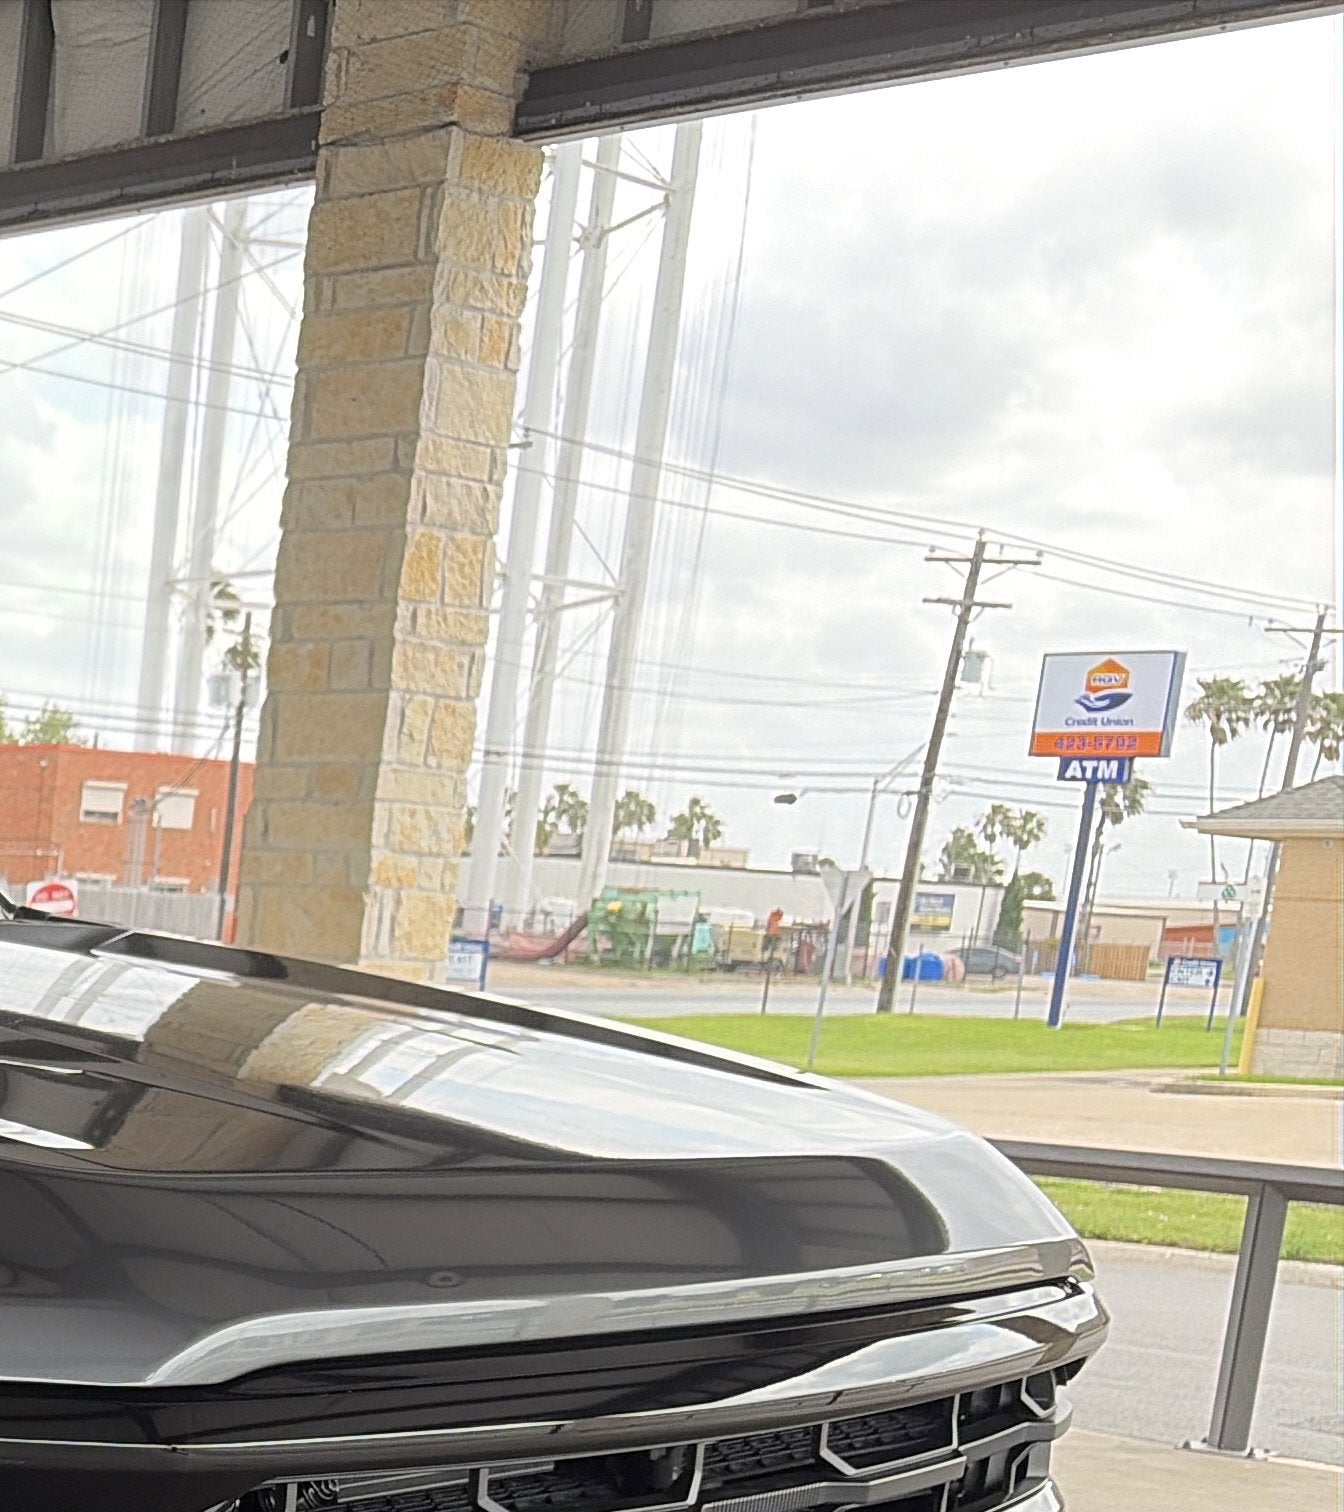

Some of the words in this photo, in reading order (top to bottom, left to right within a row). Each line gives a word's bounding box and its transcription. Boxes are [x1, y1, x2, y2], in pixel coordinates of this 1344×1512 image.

[1064, 717, 1097, 727] Credit
[1101, 717, 1135, 727] Union
[1064, 759, 1119, 779] ATM
